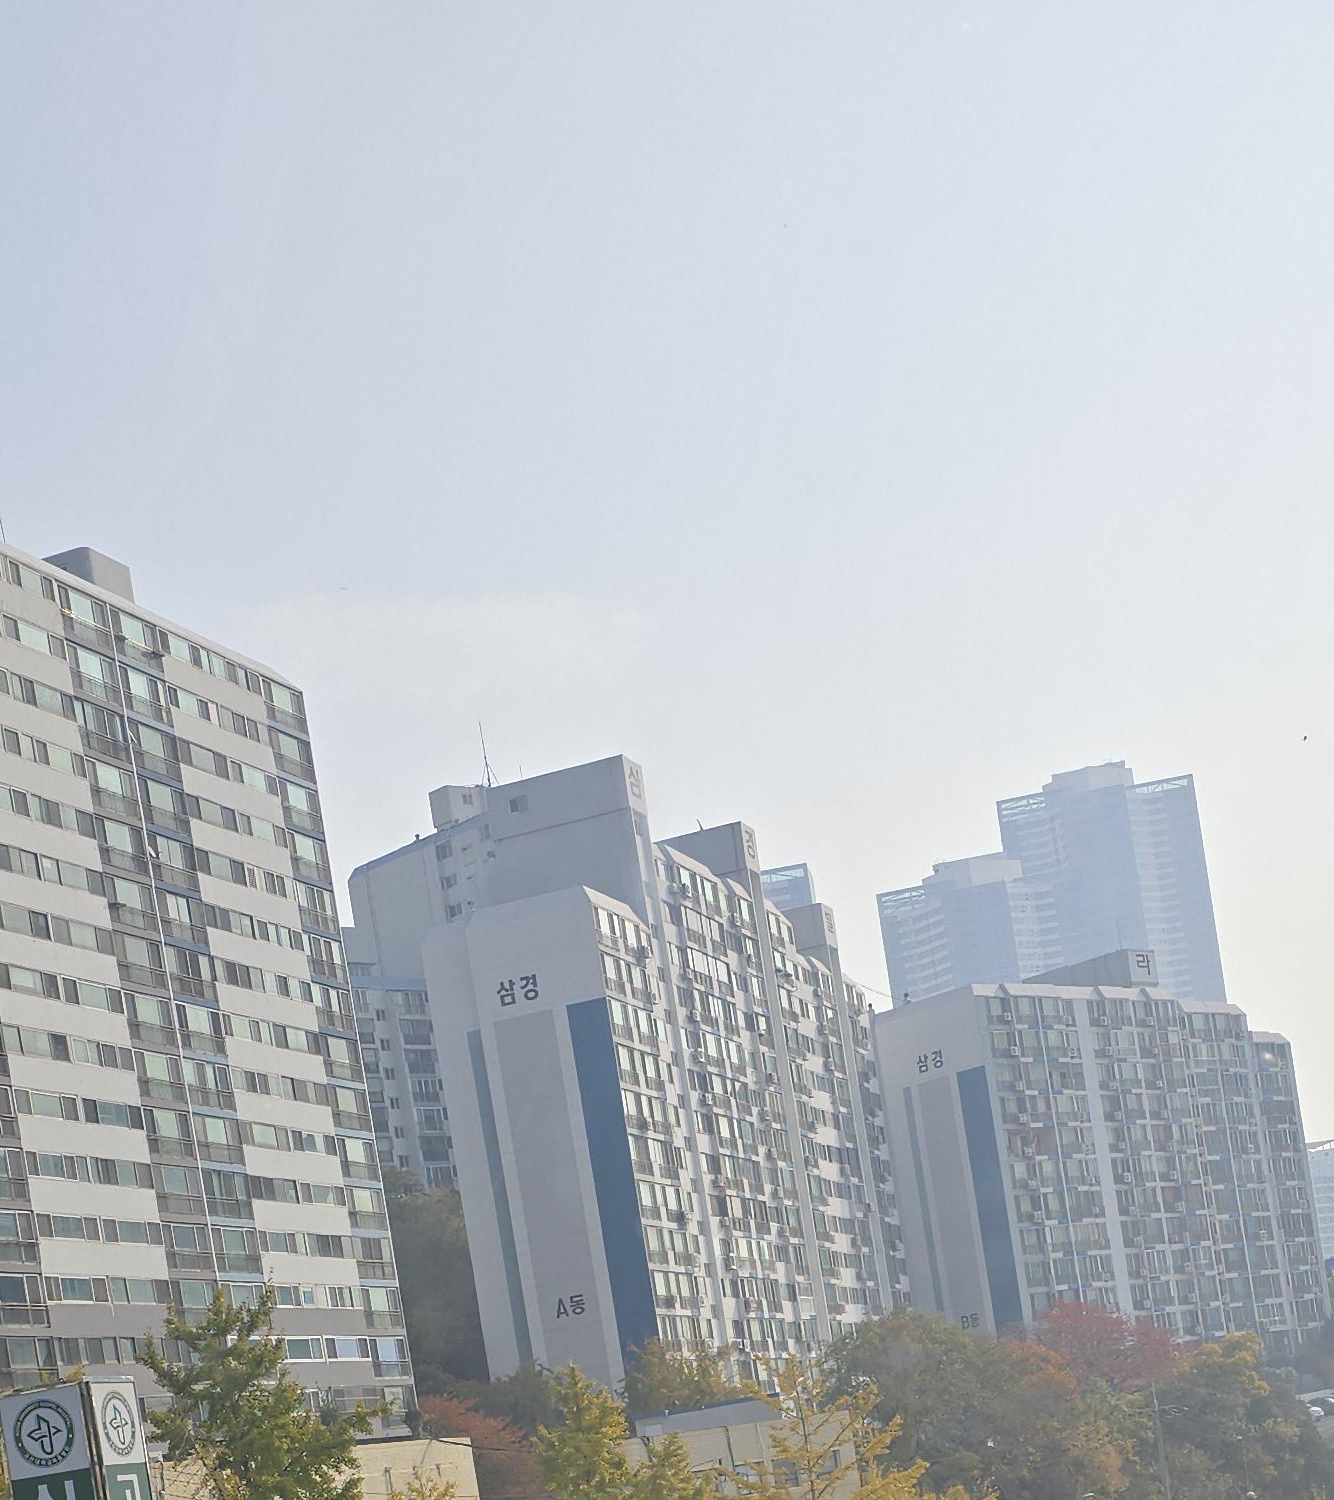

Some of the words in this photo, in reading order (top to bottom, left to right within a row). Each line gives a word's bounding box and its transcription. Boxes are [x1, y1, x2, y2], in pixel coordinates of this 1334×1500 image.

[1135, 953, 1151, 976] 라
[496, 973, 539, 1007] 삼경
[916, 1049, 944, 1073] 삼경
[556, 1294, 586, 1319] A동
[961, 1313, 980, 1329] B동
